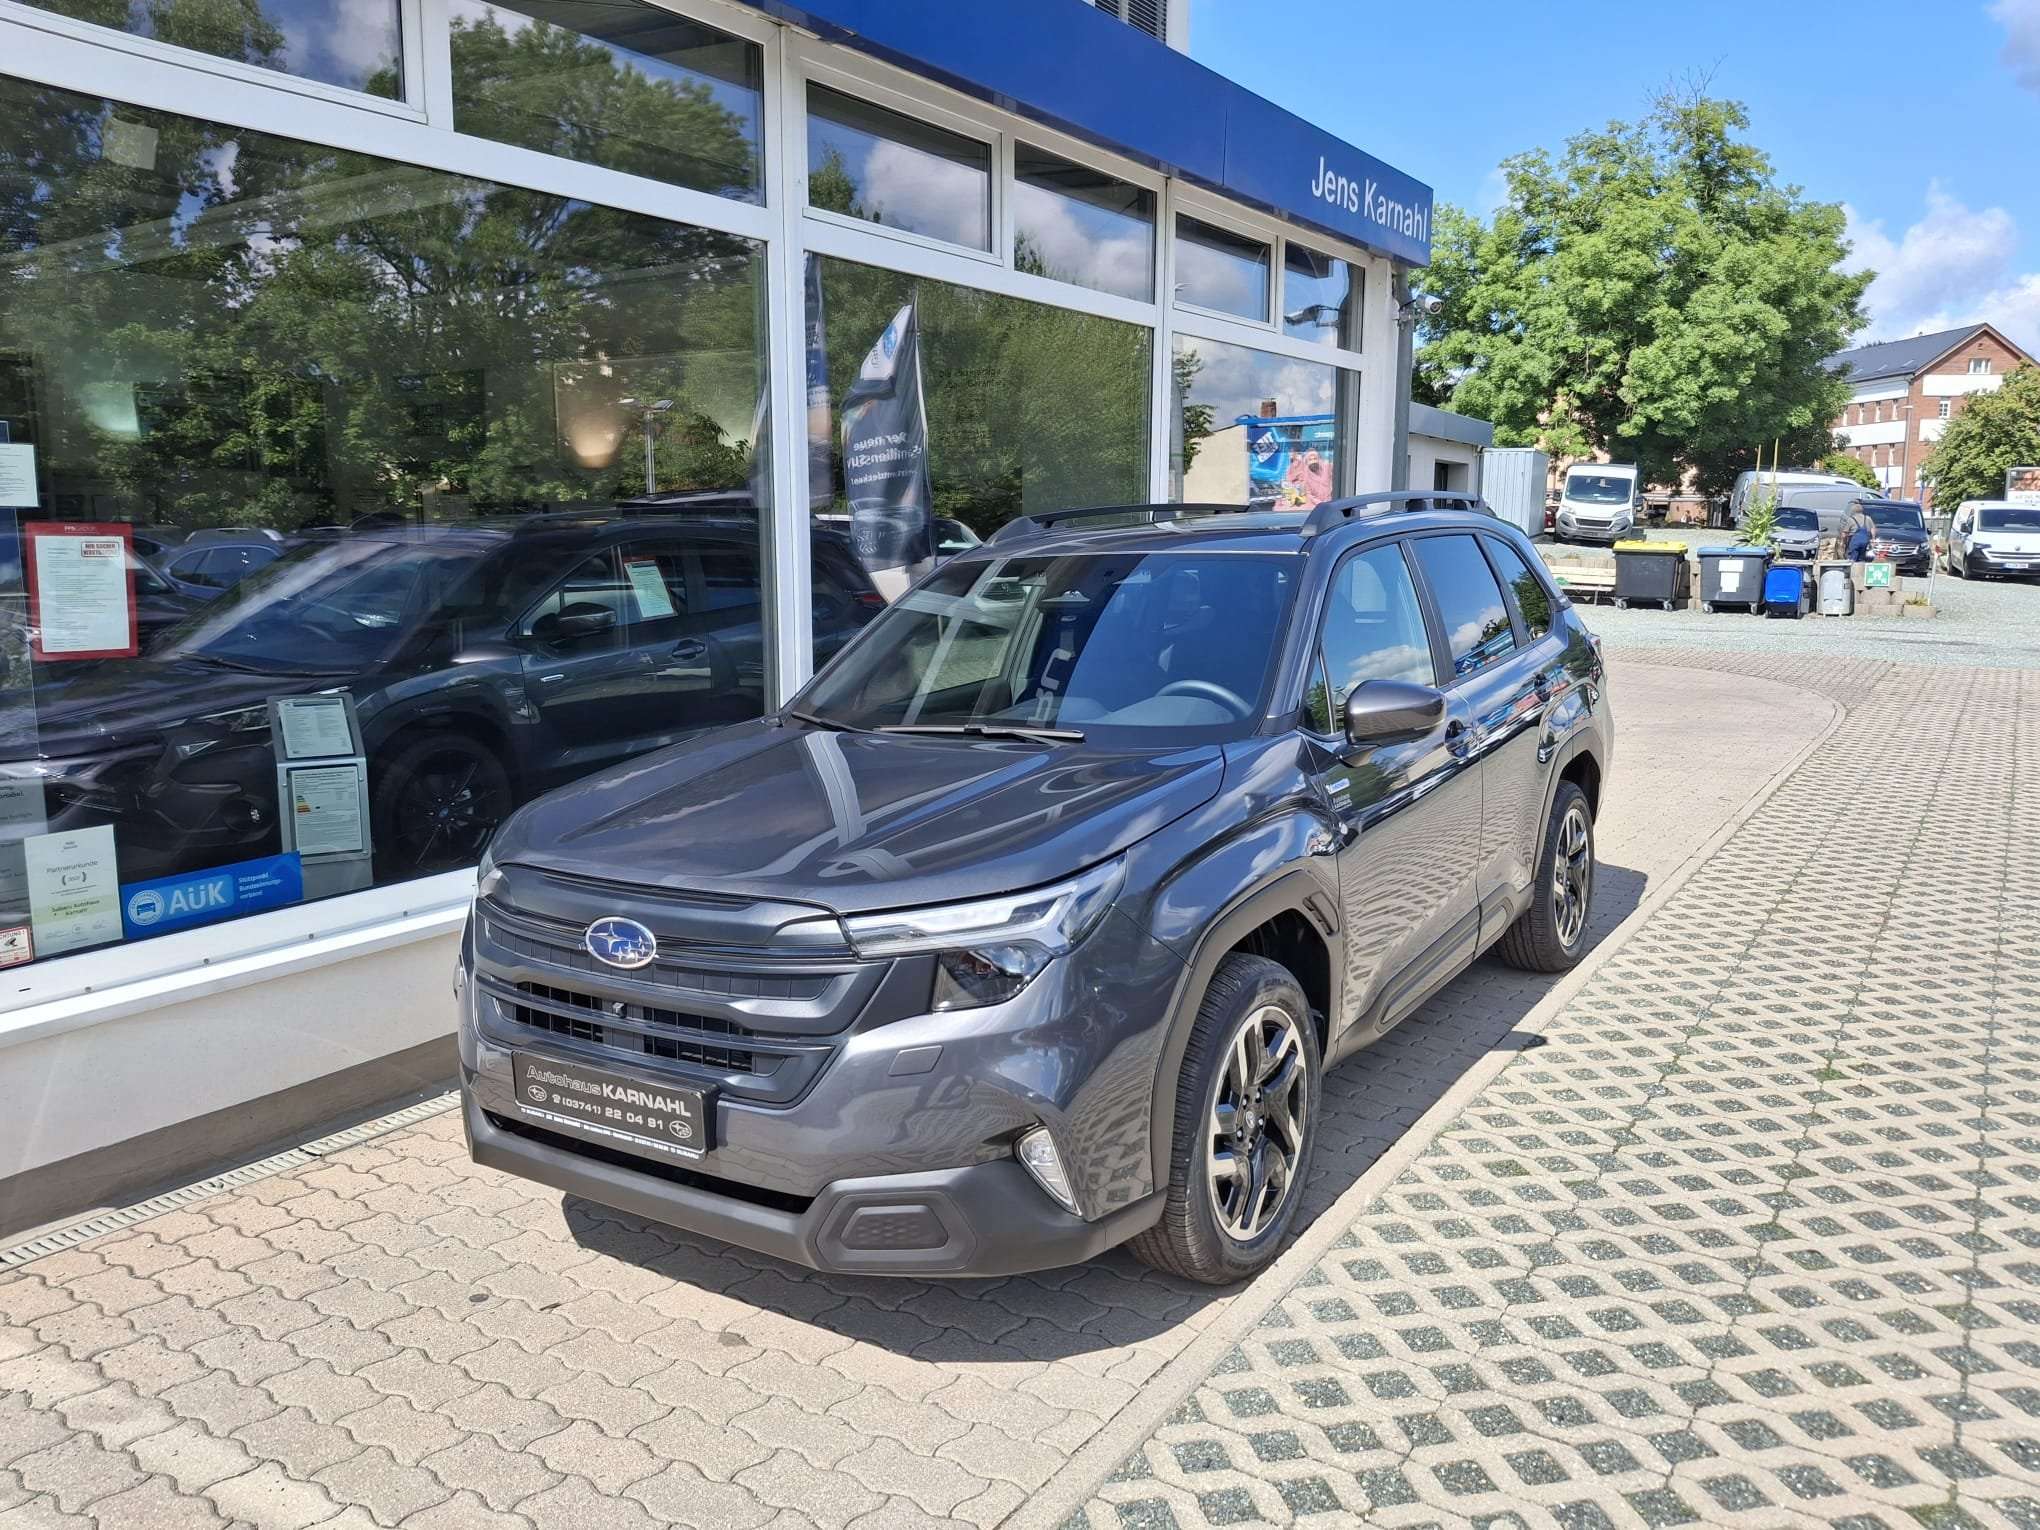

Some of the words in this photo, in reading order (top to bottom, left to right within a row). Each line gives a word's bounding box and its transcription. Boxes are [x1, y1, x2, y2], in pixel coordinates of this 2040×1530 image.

[1312, 156, 1359, 213] Jens
[1364, 178, 1428, 242] Karnahl
[563, 1097, 601, 1115] (03741)
[605, 1107, 622, 1120] 22
[627, 1113, 643, 1126] 04
